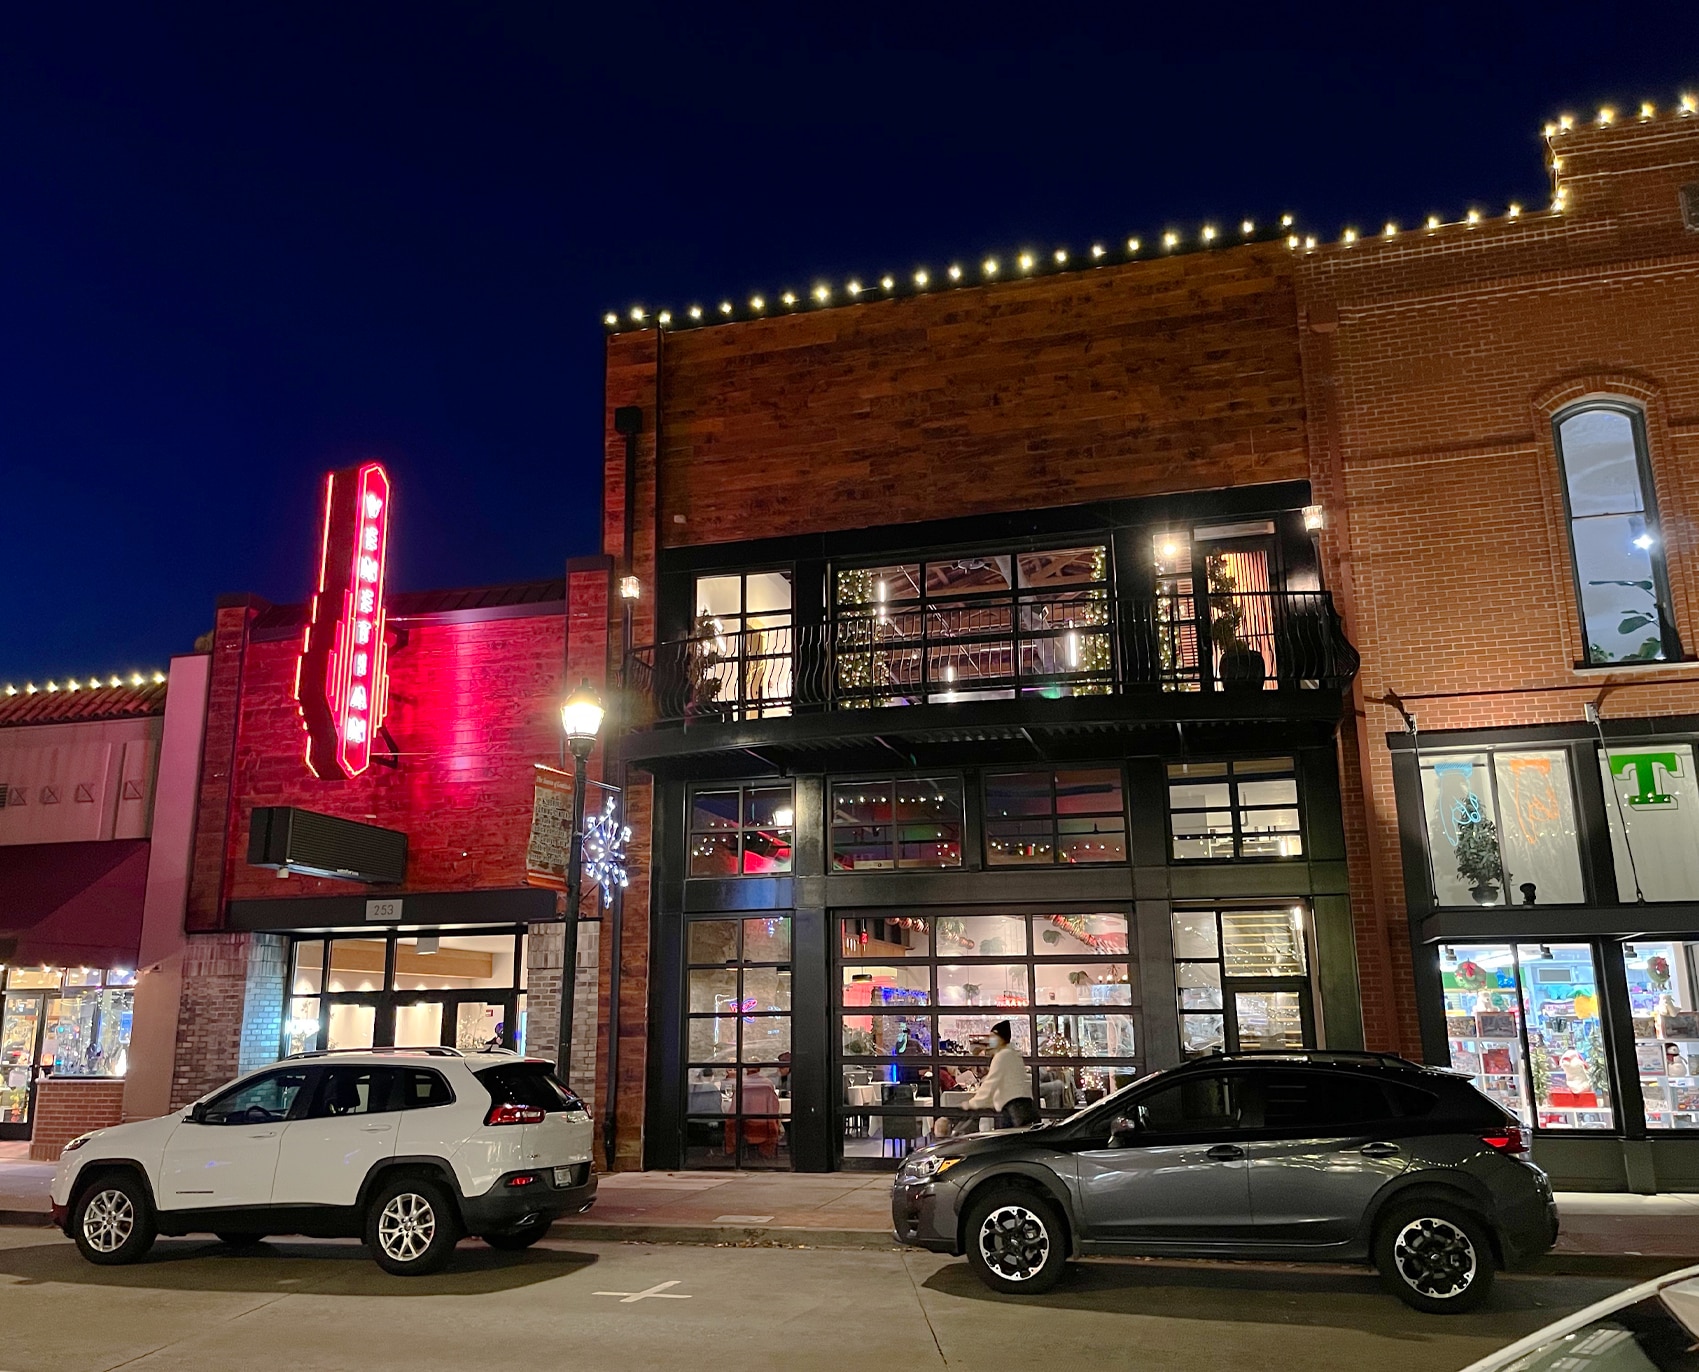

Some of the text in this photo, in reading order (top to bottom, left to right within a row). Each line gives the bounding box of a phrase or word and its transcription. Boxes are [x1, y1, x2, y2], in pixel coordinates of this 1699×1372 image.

[348, 494, 382, 742] VENETIAN
[1609, 752, 1684, 811] T
[374, 904, 394, 916] 253
